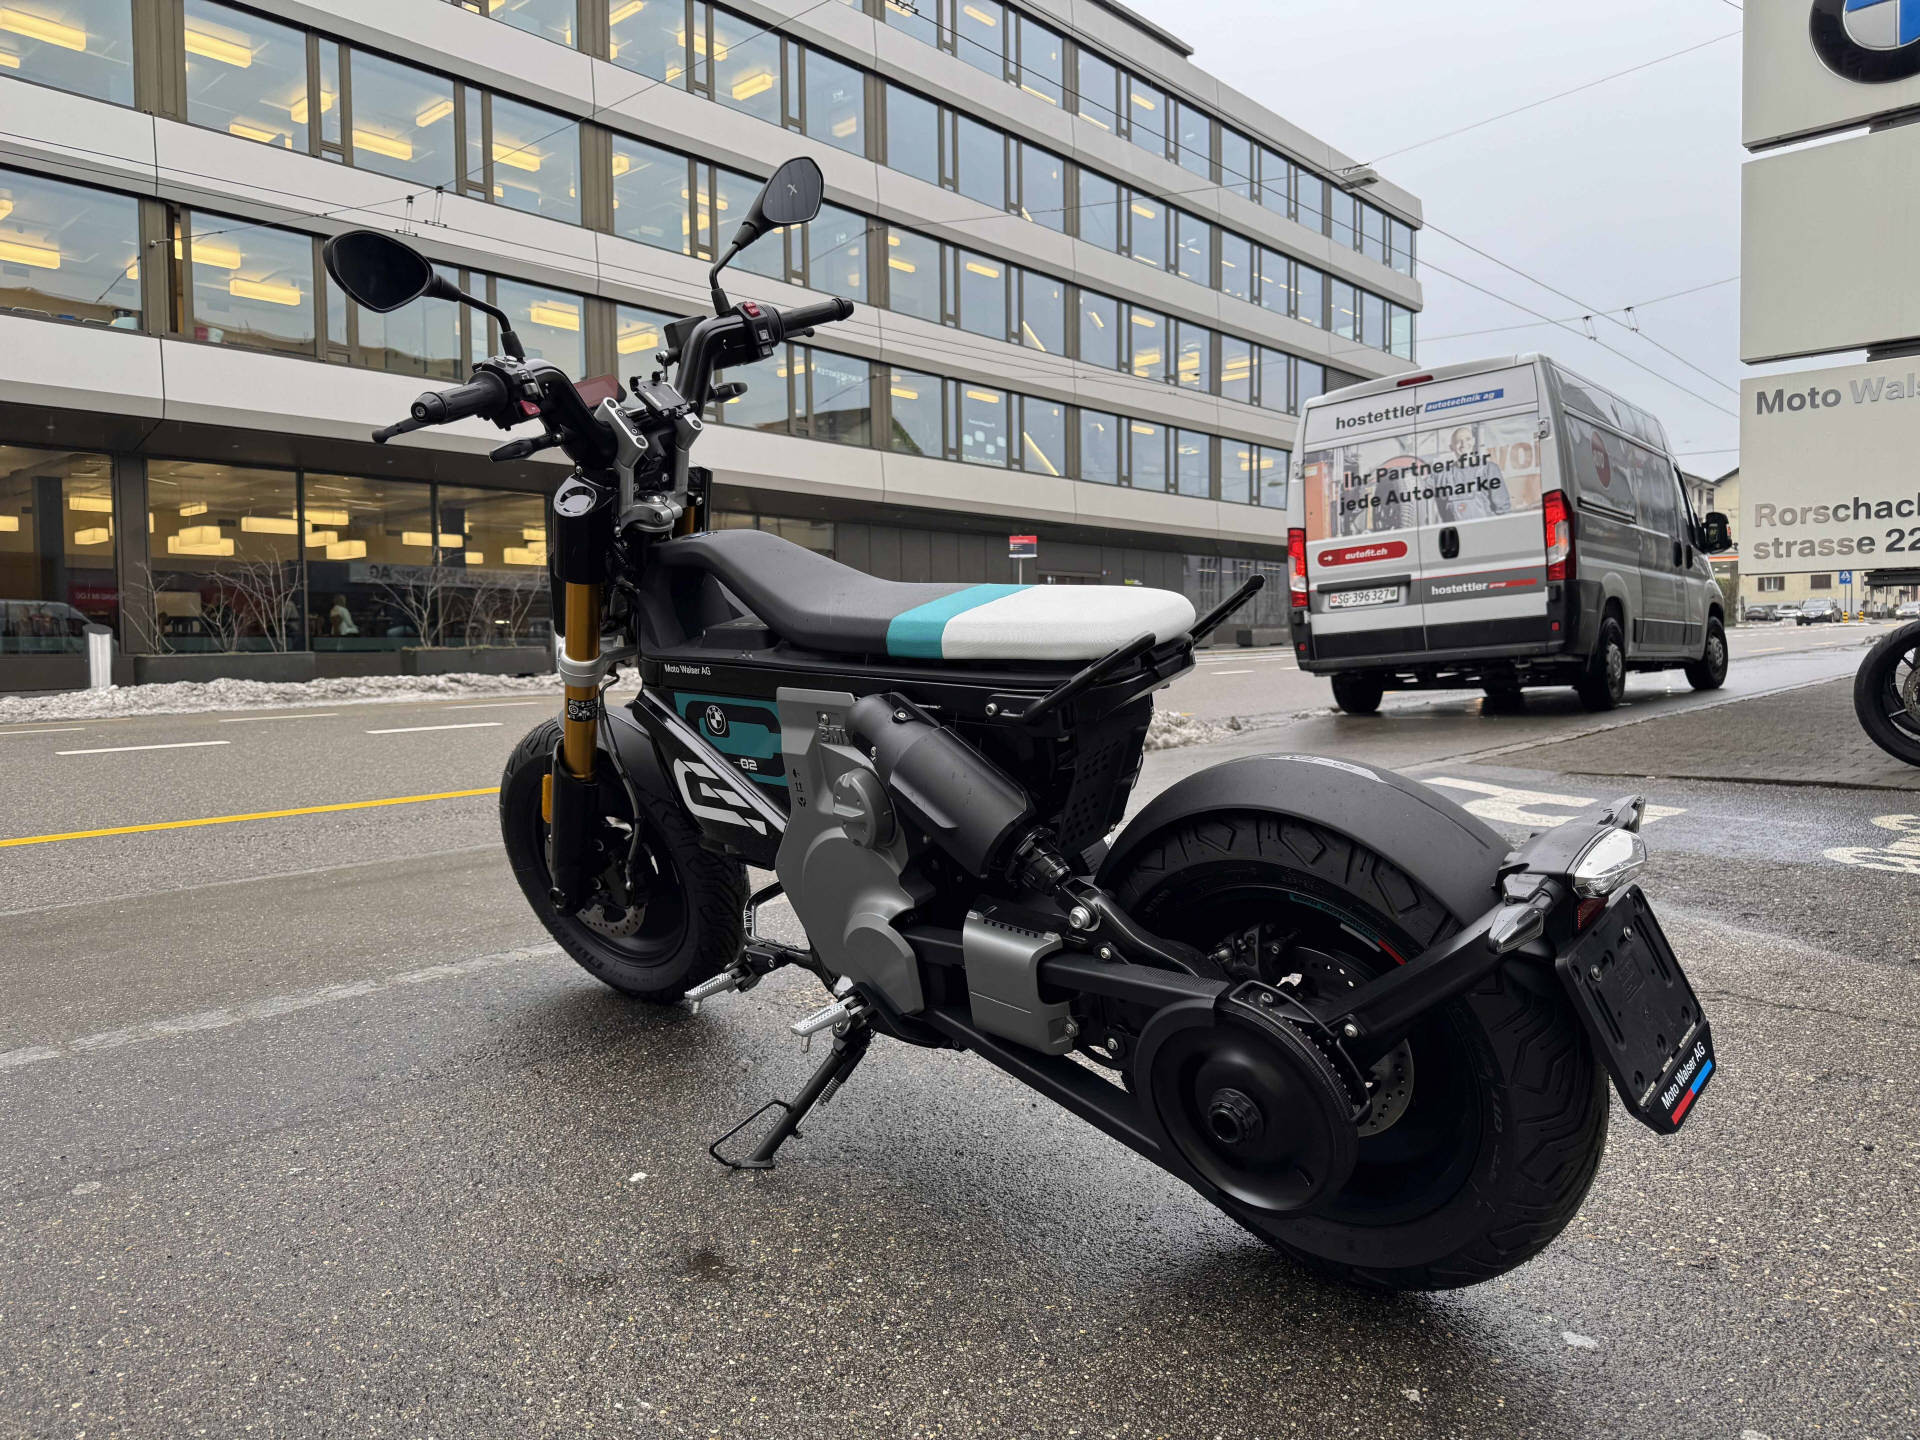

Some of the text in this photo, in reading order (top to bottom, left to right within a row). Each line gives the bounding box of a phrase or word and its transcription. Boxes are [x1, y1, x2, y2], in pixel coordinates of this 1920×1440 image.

[1336, 392, 1495, 430] hostettler autotechnik ag
[1756, 372, 1920, 415] Moto Wal
[1344, 452, 1491, 489] Ihr Partner für
[1339, 476, 1501, 515] jede Automarke
[1755, 492, 1920, 527] Rorschac
[1345, 548, 1388, 560] autofit.ch
[1753, 534, 1876, 560] strasse
[1431, 582, 1488, 595] hostettler
[664, 664, 680, 673] Moto
[701, 666, 712, 676] AG
[1661, 1041, 1706, 1110] Moto Walser AG
